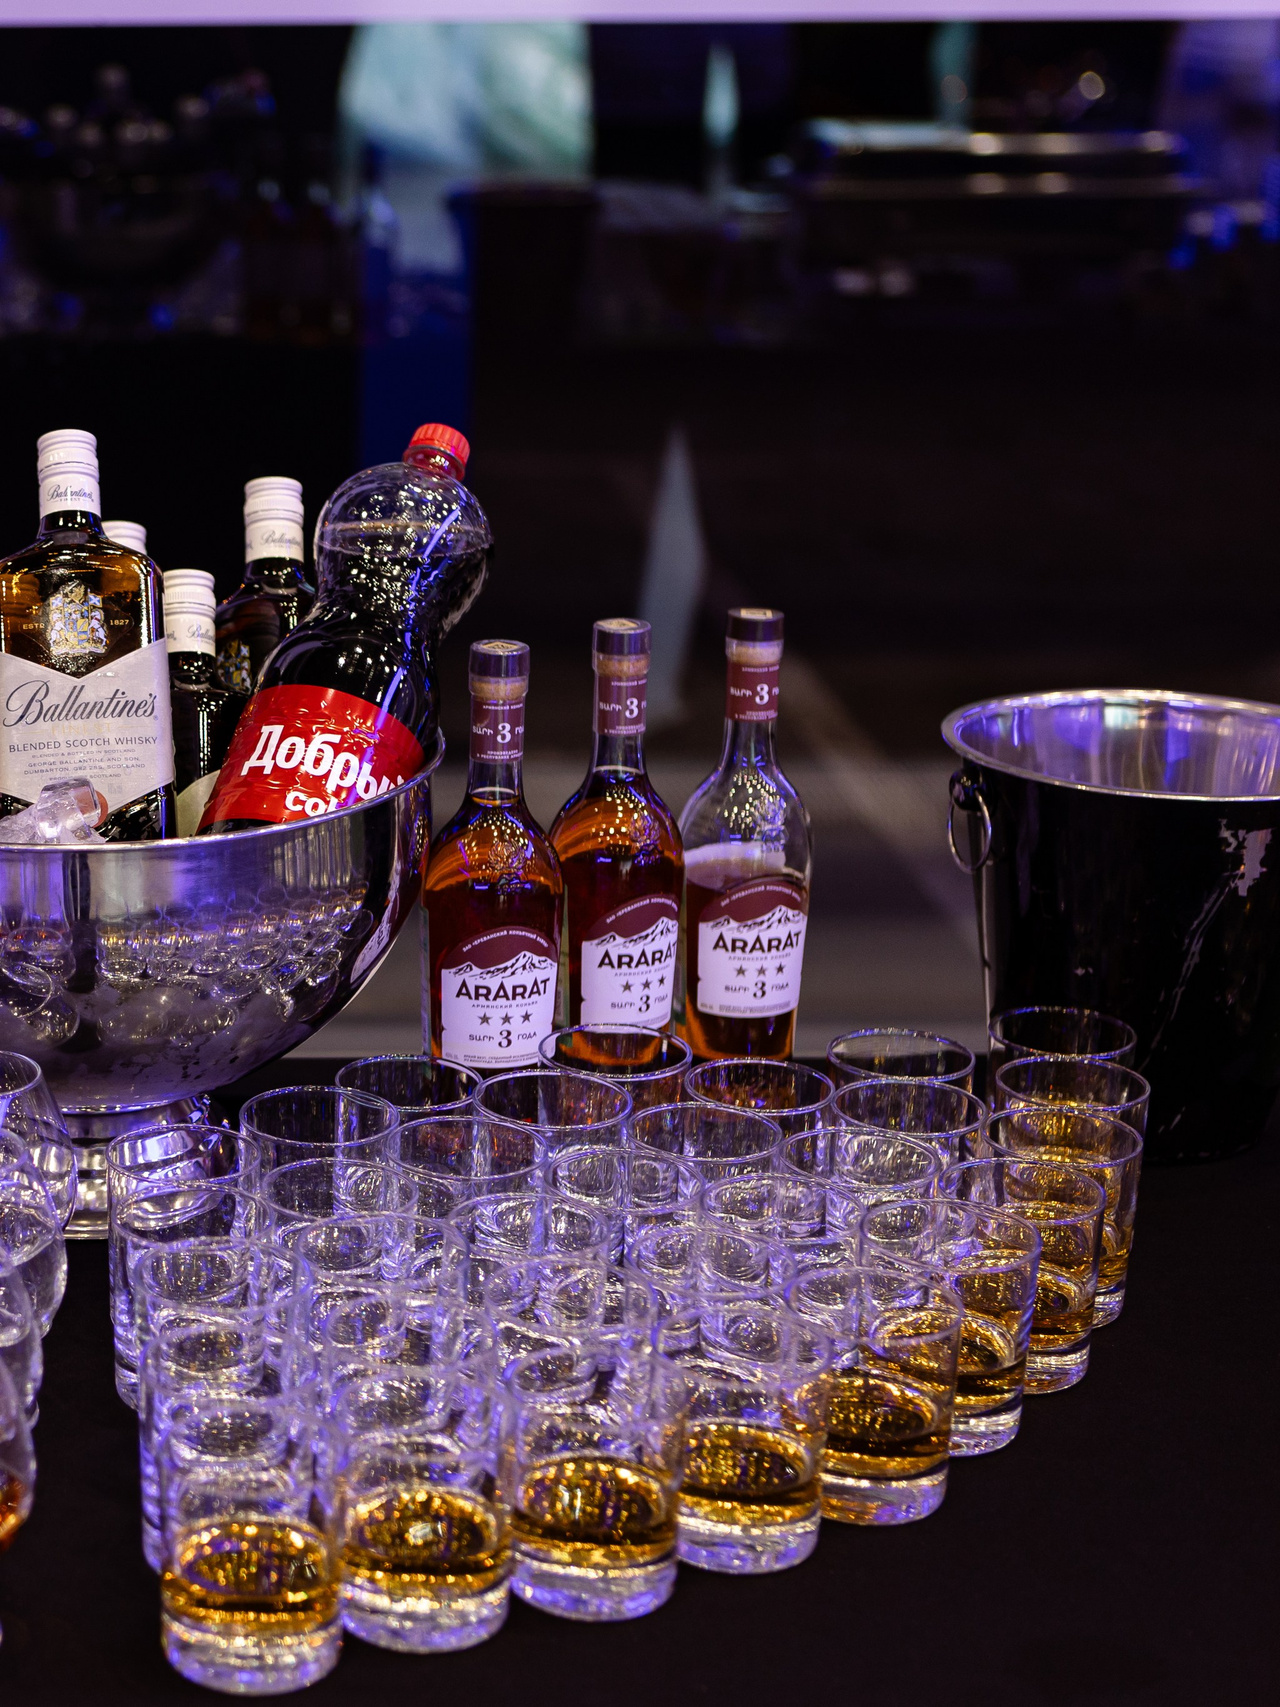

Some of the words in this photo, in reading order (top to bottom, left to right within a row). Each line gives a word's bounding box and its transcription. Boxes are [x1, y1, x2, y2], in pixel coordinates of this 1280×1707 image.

[3, 680, 157, 727] Ballantine's
[755, 683, 769, 705] 3
[625, 697, 639, 719] 3
[51, 722, 114, 736] FINEST
[497, 722, 512, 744] 3
[9, 740, 61, 753] BLENDED
[65, 738, 110, 748] SCOTCH
[115, 736, 158, 745] WHISKY
[28, 760, 57, 768] GEORGE
[59, 758, 104, 766] BALLANTINE
[712, 930, 802, 954] ARARAT
[597, 940, 677, 969] ARARAT
[455, 976, 551, 1002] ARARAT
[753, 980, 767, 999] 3
[638, 994, 651, 1013] 3
[498, 1029, 512, 1049] 3
[517, 1031, 538, 1041] ГОДА
